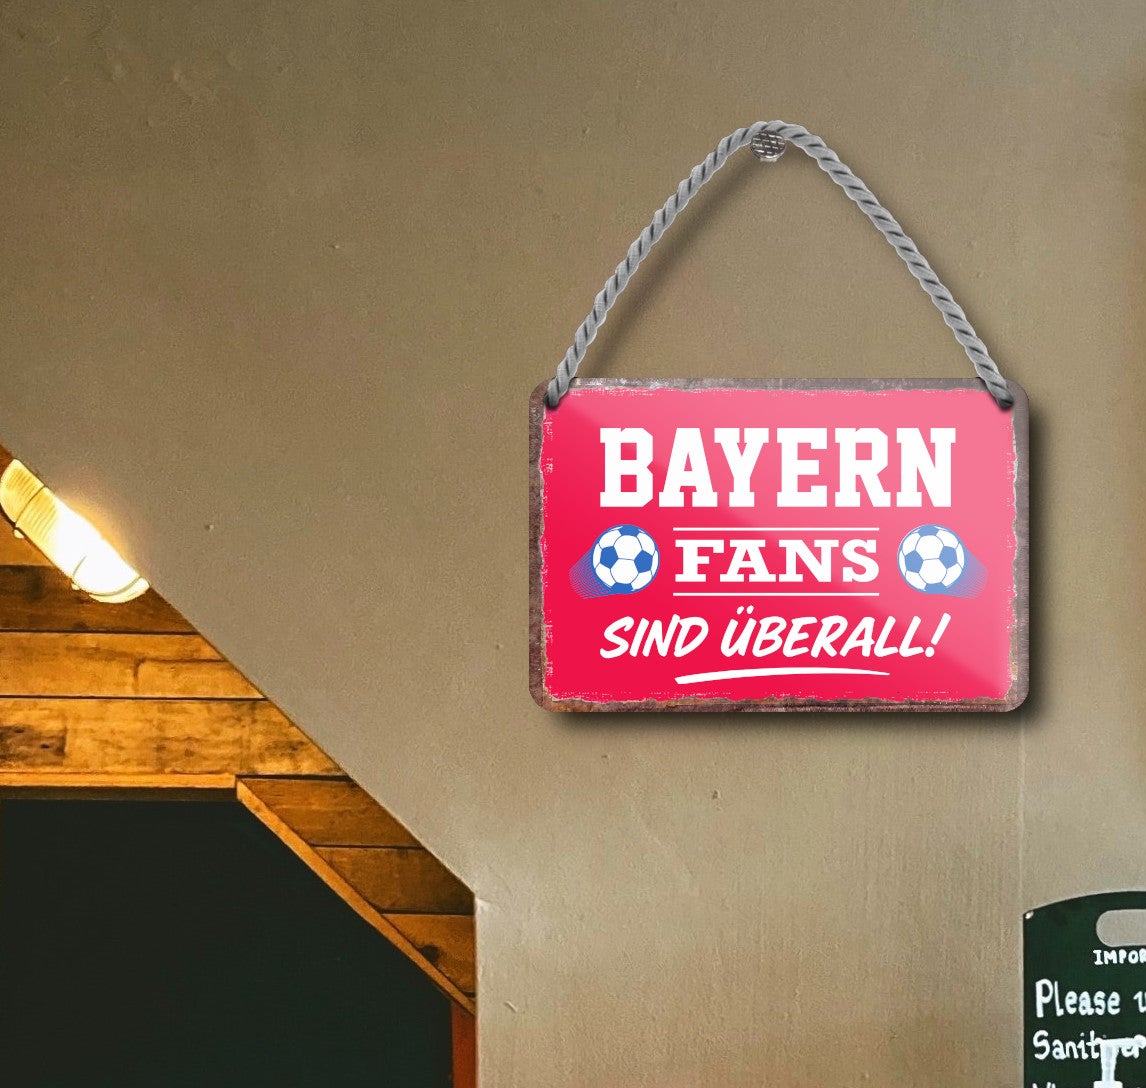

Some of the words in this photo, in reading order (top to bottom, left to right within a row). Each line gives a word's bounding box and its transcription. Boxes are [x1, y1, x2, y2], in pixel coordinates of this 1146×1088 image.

[599, 427, 956, 507] BAYERN
[674, 538, 880, 583] FANS
[600, 613, 709, 658] SIND
[720, 605, 951, 658] ÜBERALL!
[1035, 978, 1121, 1018] Please
